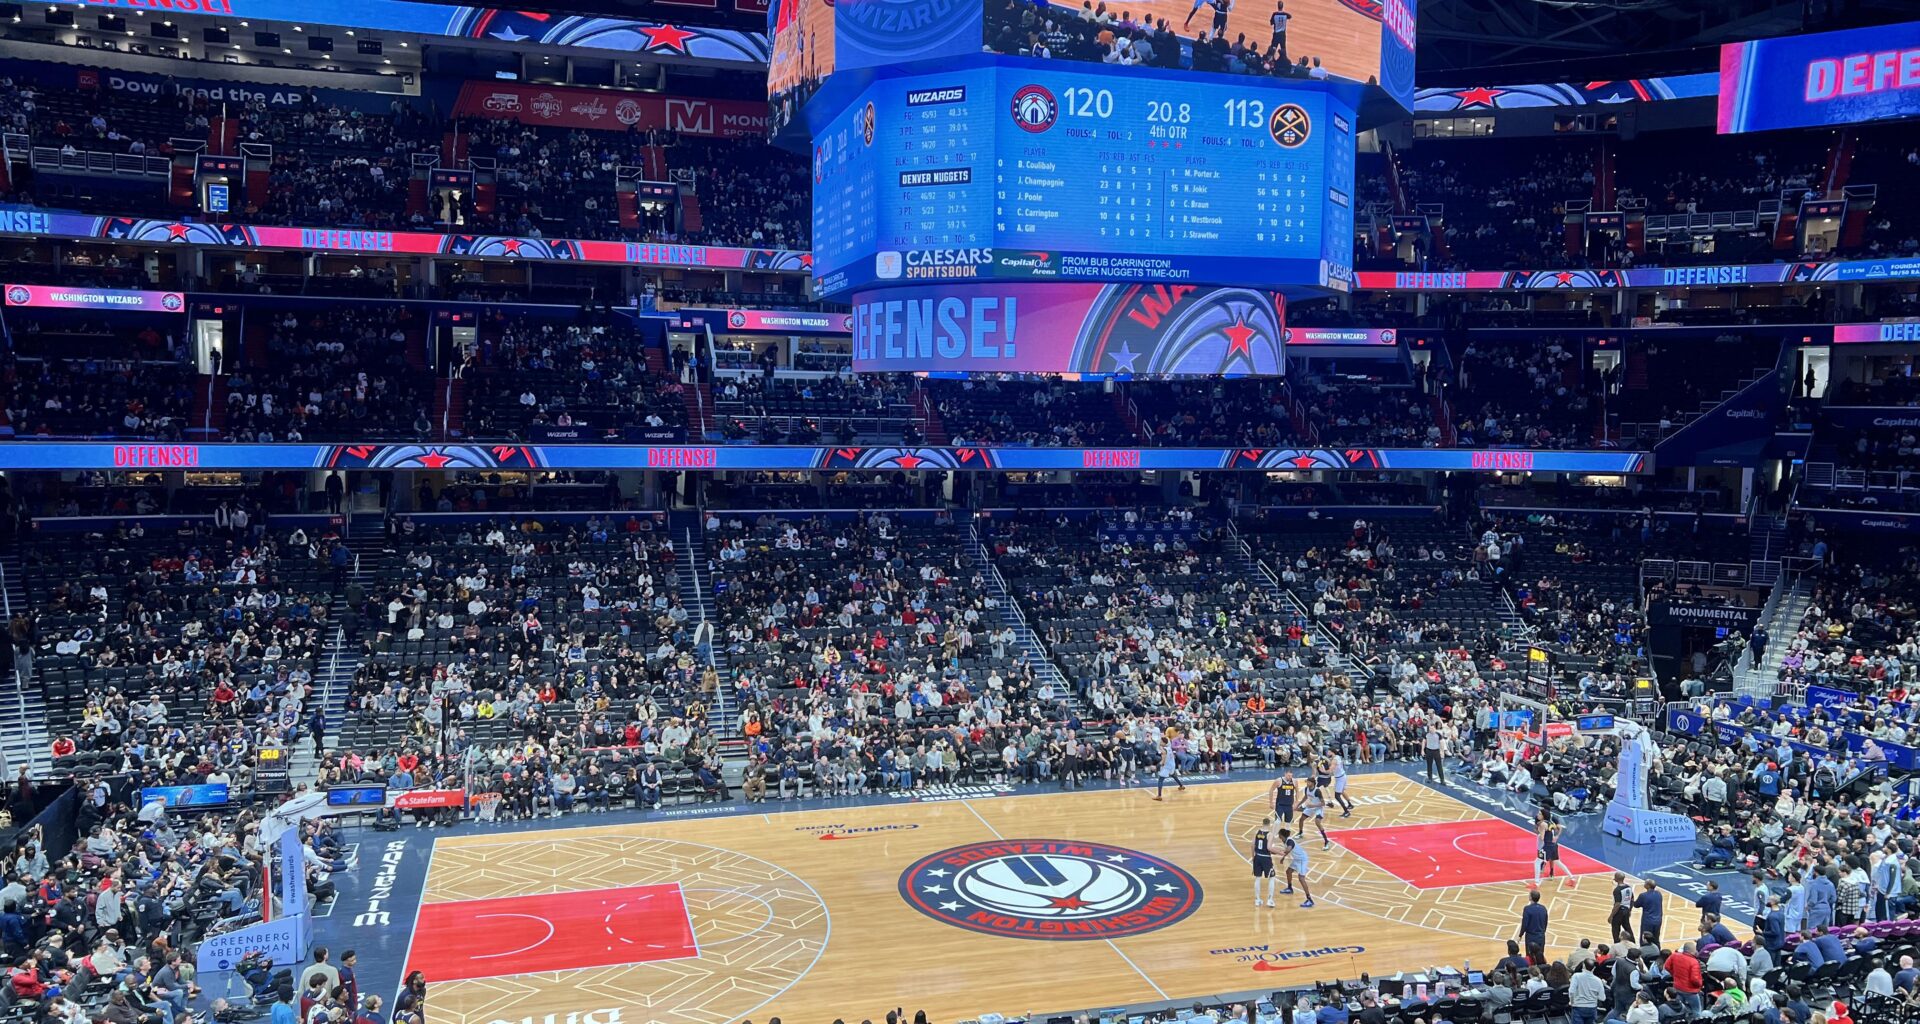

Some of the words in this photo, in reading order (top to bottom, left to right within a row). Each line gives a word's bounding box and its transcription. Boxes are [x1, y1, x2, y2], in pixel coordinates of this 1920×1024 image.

[228, 88, 266, 103] the
[910, 90, 962, 103] WIZARDS
[1063, 88, 1114, 118] 120
[1147, 101, 1190, 124] 20.8
[1224, 99, 1264, 128] 113
[1092, 129, 1096, 138] 4
[1128, 132, 1132, 140] 2
[1150, 126, 1166, 138] 4th
[1226, 138, 1231, 146] 4
[1260, 140, 1264, 148] 0
[1026, 161, 1056, 172] Coulibaly
[902, 173, 931, 184] DENVER
[934, 171, 968, 182] NUGGETS
[1025, 177, 1064, 188] Champagnie
[1192, 186, 1208, 194] Jokic
[1025, 193, 1042, 201] Poole
[1025, 208, 1059, 219] Carrington
[1191, 216, 1222, 225] Westbrook
[1025, 224, 1035, 232] Gill
[302, 229, 393, 250] DEFENSE!
[1190, 231, 1219, 240] Strawther
[626, 243, 706, 264] DEFENSE!
[906, 248, 993, 265] CAESARS
[1062, 256, 1088, 266] FROM
[1090, 258, 1108, 266] BUB
[1110, 259, 1171, 268] CARRINGTON!
[907, 266, 976, 278] SPORTSBOOK
[1062, 267, 1099, 275] DENVER
[1100, 268, 1144, 277] NUGGETS
[1147, 269, 1190, 278] TIME-OUT!
[1664, 266, 1746, 285] DEFENSE!
[1396, 272, 1466, 287] DEFENSE!
[50, 292, 104, 303] WASHINGTON
[106, 295, 143, 305] WIZARDS
[760, 317, 801, 326] WASHINGTON
[803, 318, 829, 326] WIZARDS
[852, 296, 1017, 360] DEFENSE!
[114, 447, 198, 466] DEFENSE!
[648, 449, 716, 467] DEFENSE!
[1084, 450, 1140, 467] DEFENSE!
[1472, 452, 1533, 468] DEFENSE!
[1670, 606, 1748, 620] MONUMENTAL
[260, 748, 279, 760] 20.8
[1644, 818, 1689, 826] GREENBERG
[1258, 840, 1262, 850] 0
[944, 842, 1093, 868] WIZARDS
[966, 896, 1181, 936] WASHINGTON
[210, 932, 290, 947] GREENBERG
[1210, 945, 1268, 954] Arena
